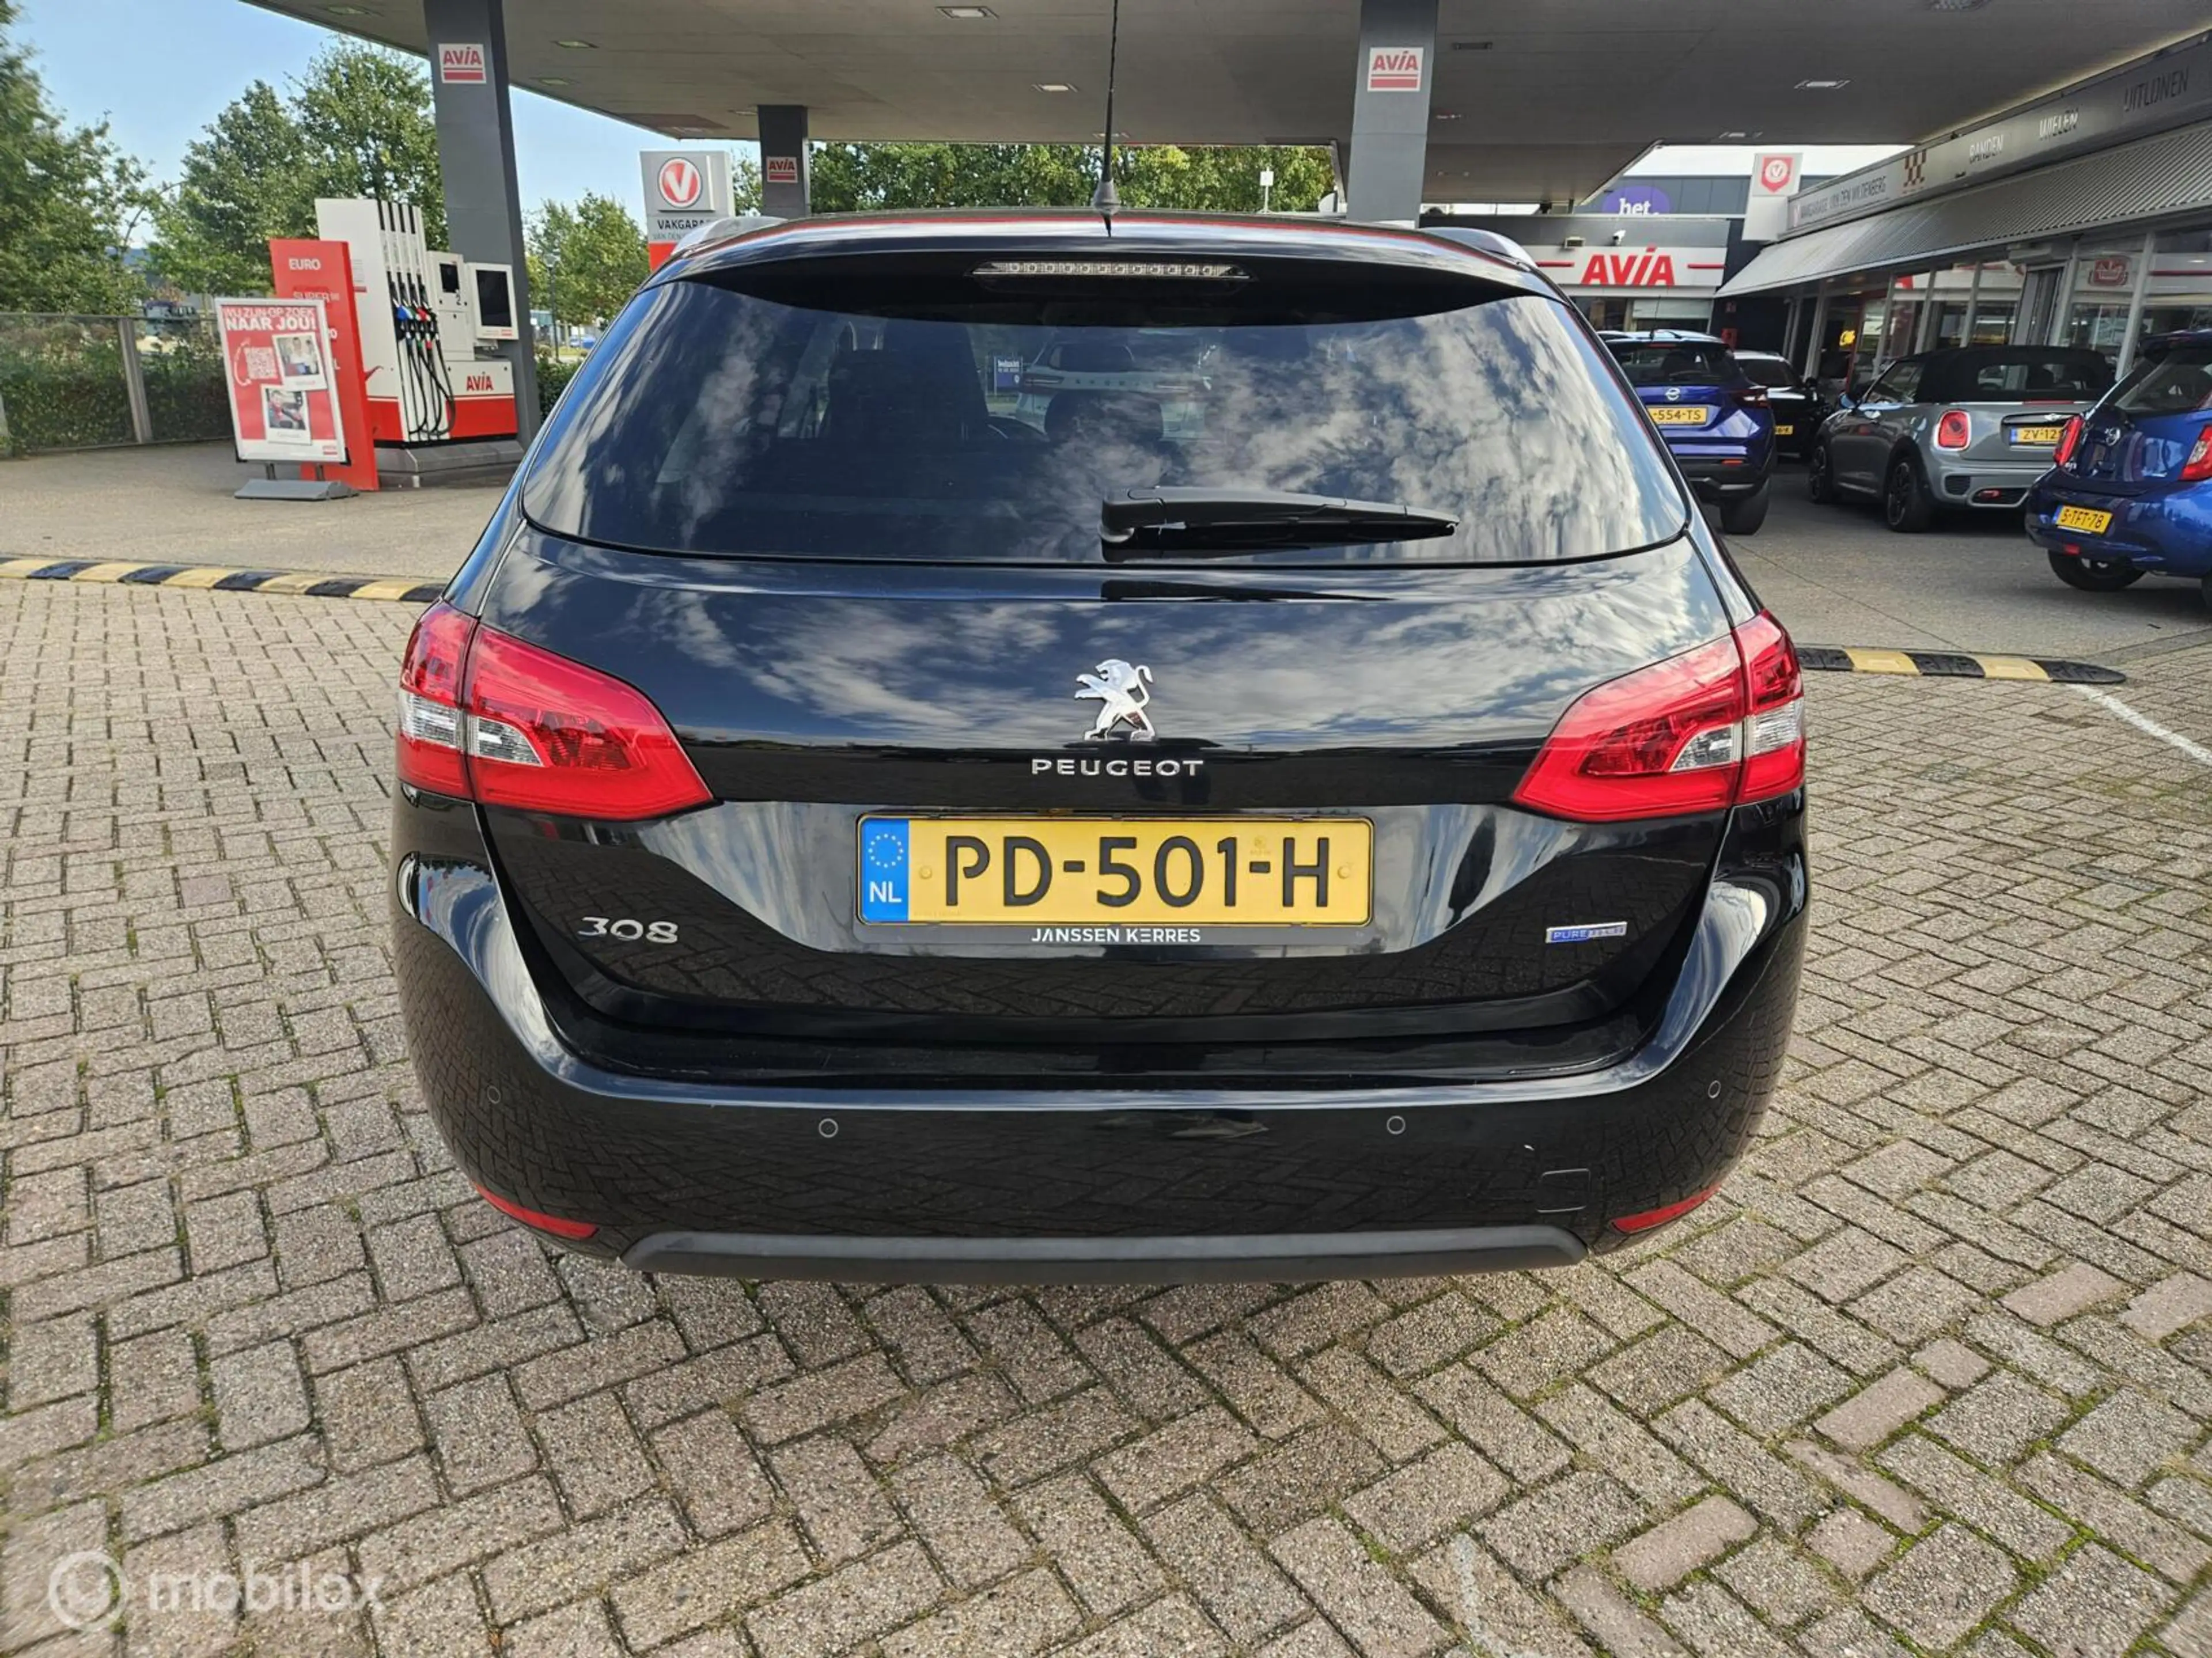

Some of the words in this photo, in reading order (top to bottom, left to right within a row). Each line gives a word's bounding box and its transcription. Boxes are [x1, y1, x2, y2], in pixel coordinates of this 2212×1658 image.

[444, 46, 482, 65] AVIA
[1373, 50, 1418, 71] AVIA
[768, 158, 795, 170] AVIA
[657, 219, 711, 229] VAKGARA
[289, 258, 321, 270] EURO
[1581, 245, 1675, 287] AVIA
[226, 317, 273, 331] NAAR
[276, 316, 316, 331] JOU!
[467, 371, 494, 391] AVIA
[1652, 409, 1701, 421] -554-TS
[2061, 509, 2104, 529] 5-TFT-78
[1032, 758, 1203, 776] PEUGEOT
[945, 836, 1330, 908] PD-501-H
[869, 881, 902, 902] NL
[578, 917, 679, 943] 308
[1032, 928, 1120, 942] JANSSEN
[1126, 928, 1201, 943] KERRES
